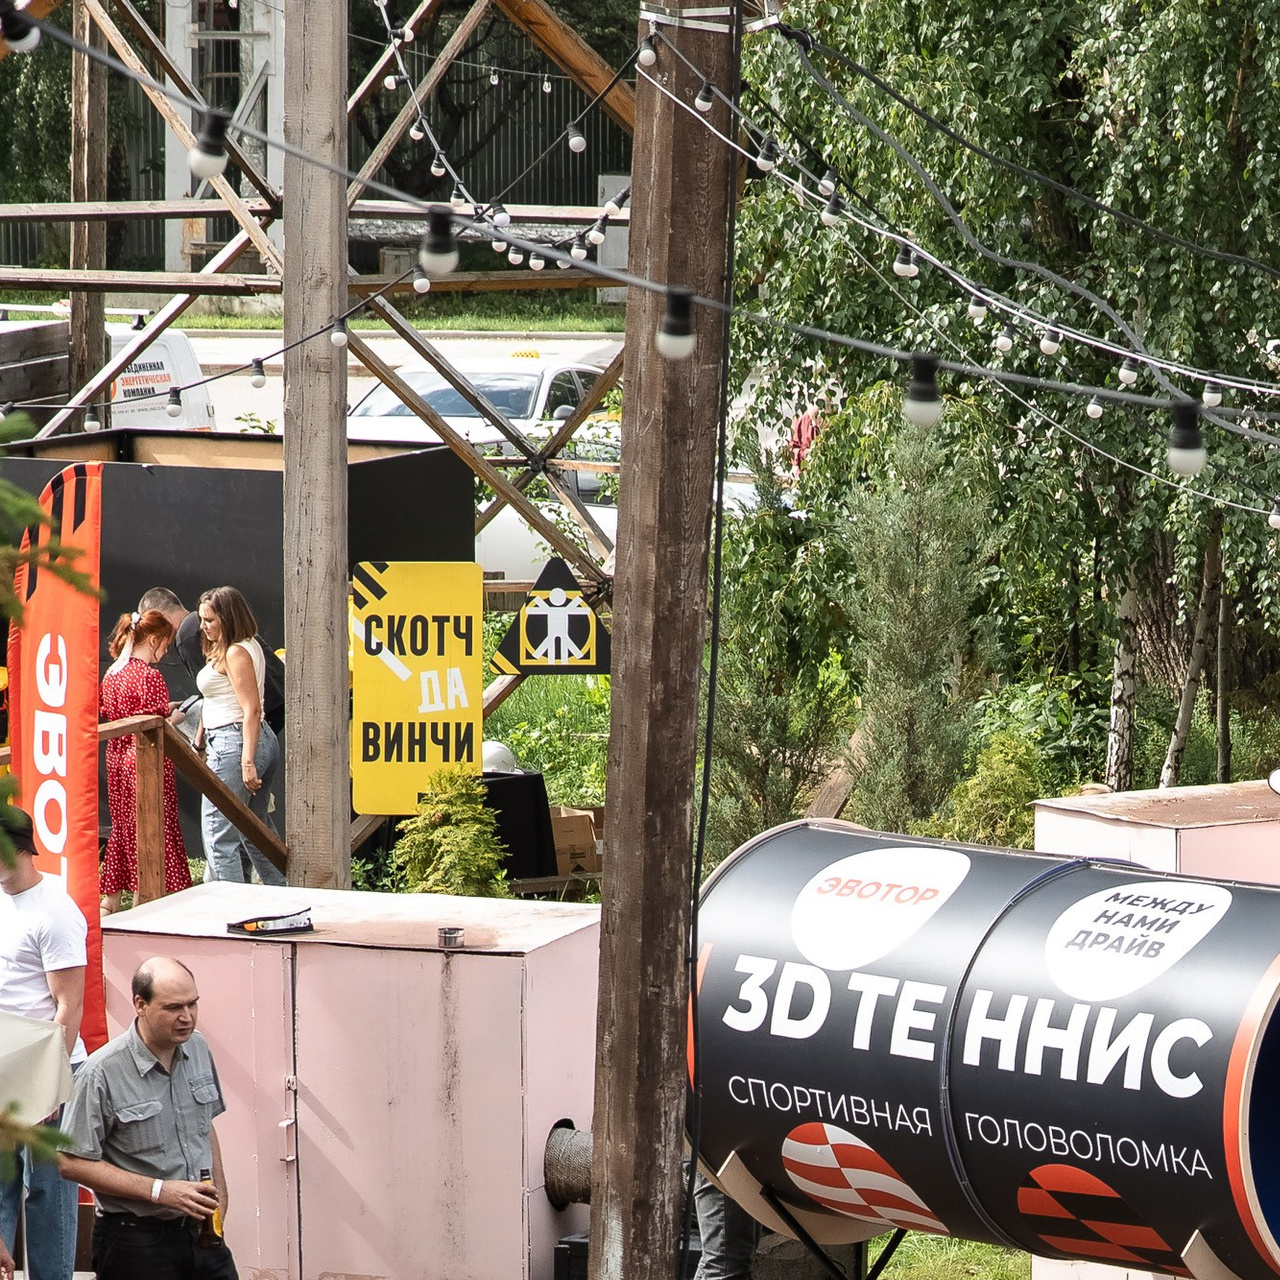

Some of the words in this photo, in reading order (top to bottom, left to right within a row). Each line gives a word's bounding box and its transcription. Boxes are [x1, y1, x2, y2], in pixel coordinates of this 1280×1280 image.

[120, 373, 171, 386] ЭНЕРГЕТИЧЕСКАЯ
[122, 386, 156, 398] КОМПАНИЯ
[364, 614, 474, 657] СКОТЧ
[417, 667, 470, 714] ДА
[362, 721, 474, 763] ВИНЧИ
[816, 876, 940, 906] ЭВОТОР
[1104, 892, 1215, 916] МЕЖДУ
[1093, 909, 1181, 934] НАМИ
[1064, 929, 1167, 959] ДРАЙВ
[721, 954, 832, 1040] 3D
[728, 1075, 934, 1137] СПОРТИВНАЯ
[965, 1112, 1213, 1180] ГОЛОВОЛОМКА
